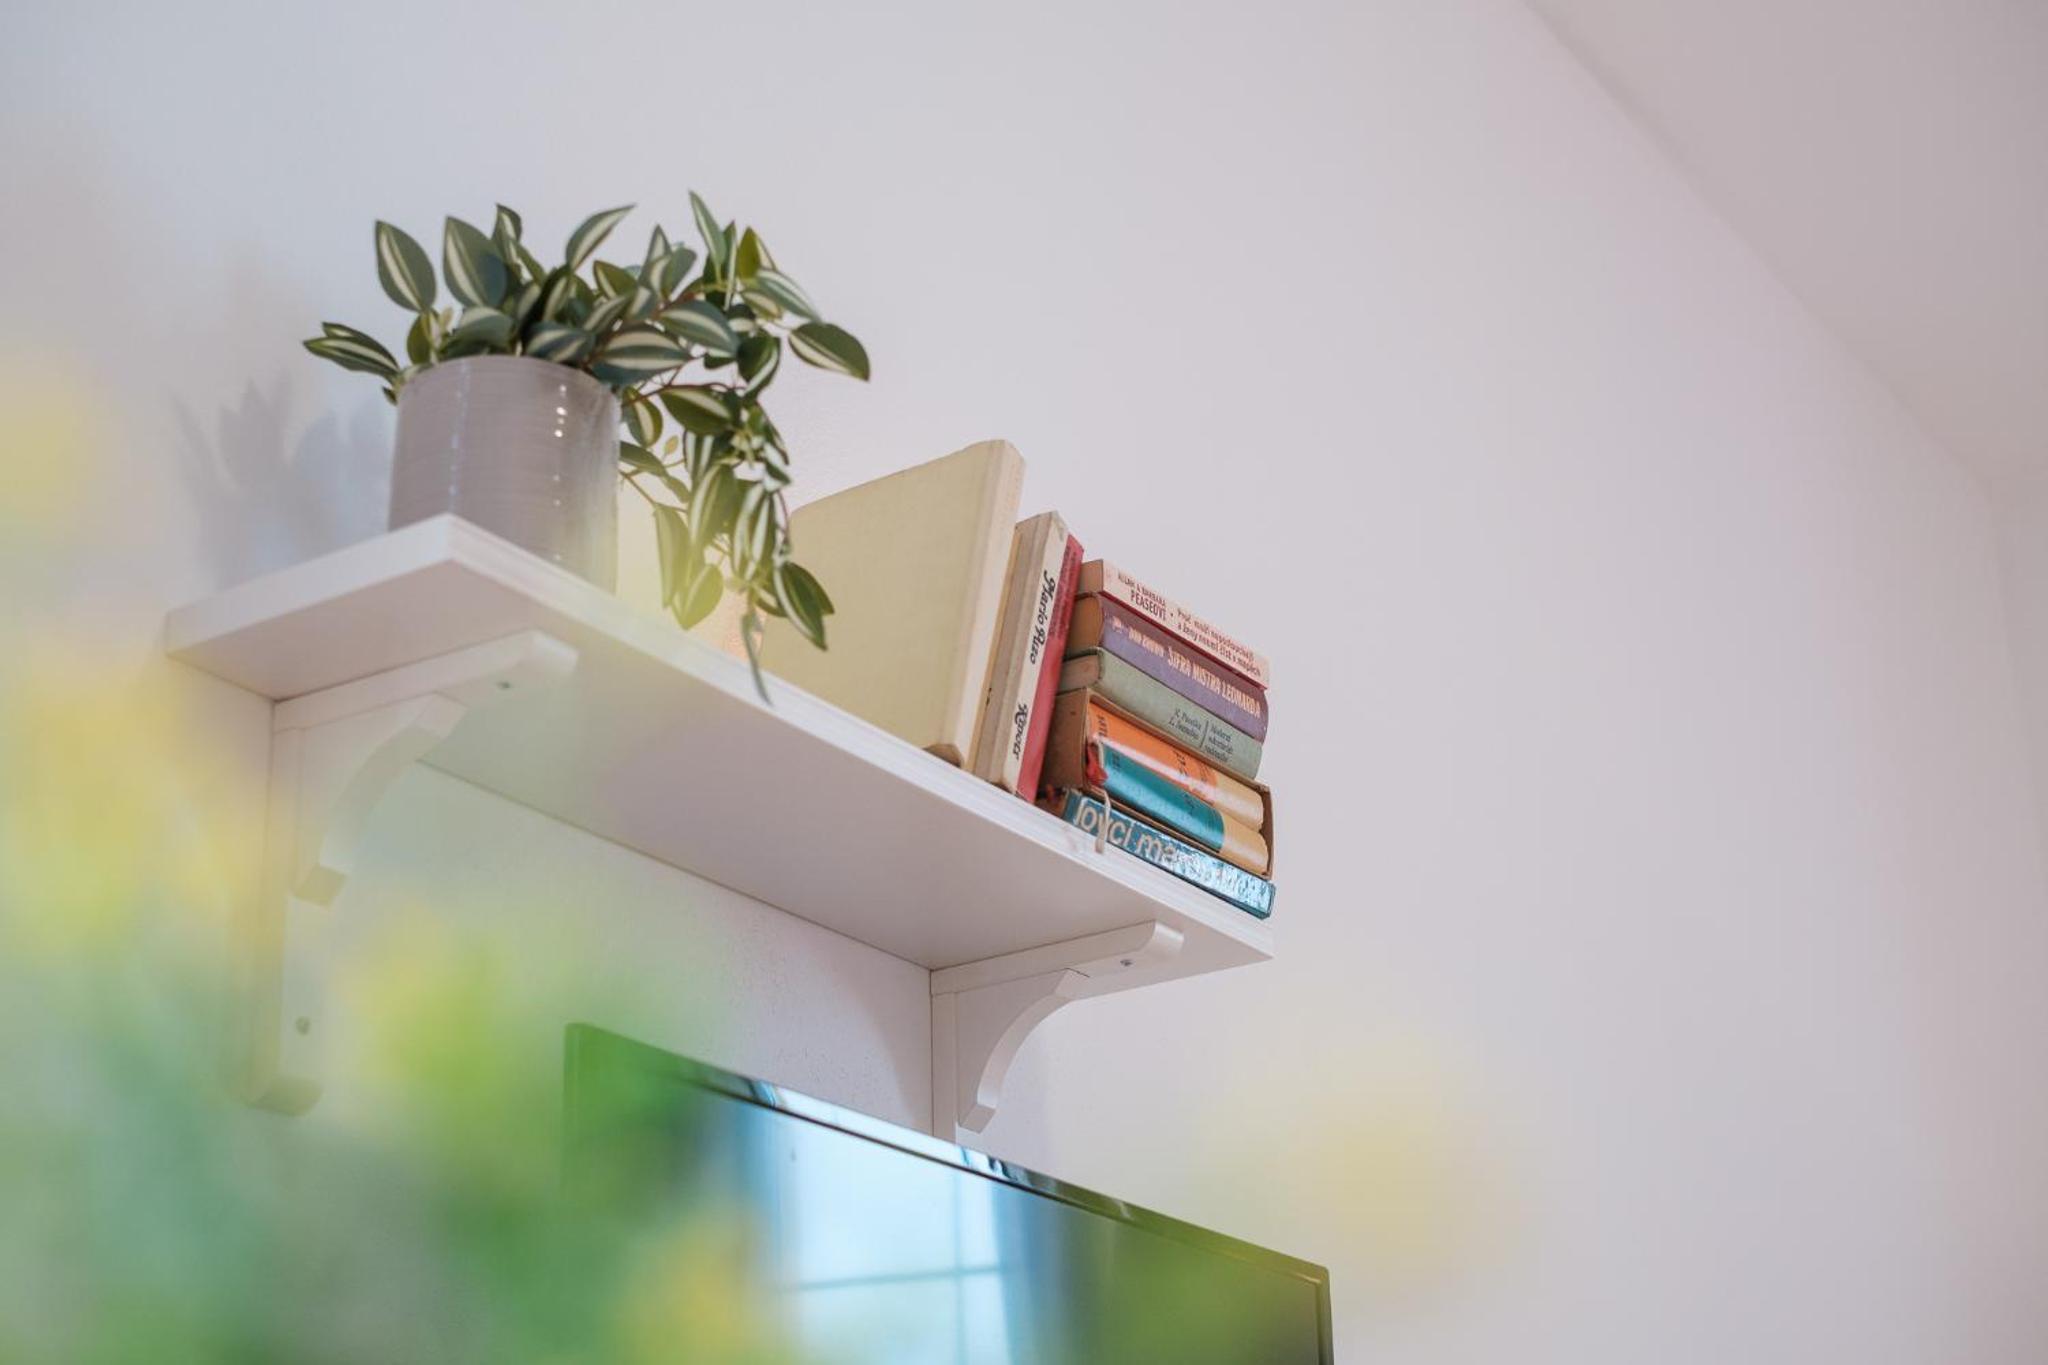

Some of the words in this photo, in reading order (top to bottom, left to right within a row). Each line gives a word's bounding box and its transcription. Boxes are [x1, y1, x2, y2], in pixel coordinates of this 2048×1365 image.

[1037, 570, 1055, 624] Mario
[1131, 590, 1166, 621] PEASEOVI
[1030, 625, 1046, 664] Puzo
[1192, 662, 1221, 695] MISTRA
[1221, 679, 1261, 718] LEONARDA
